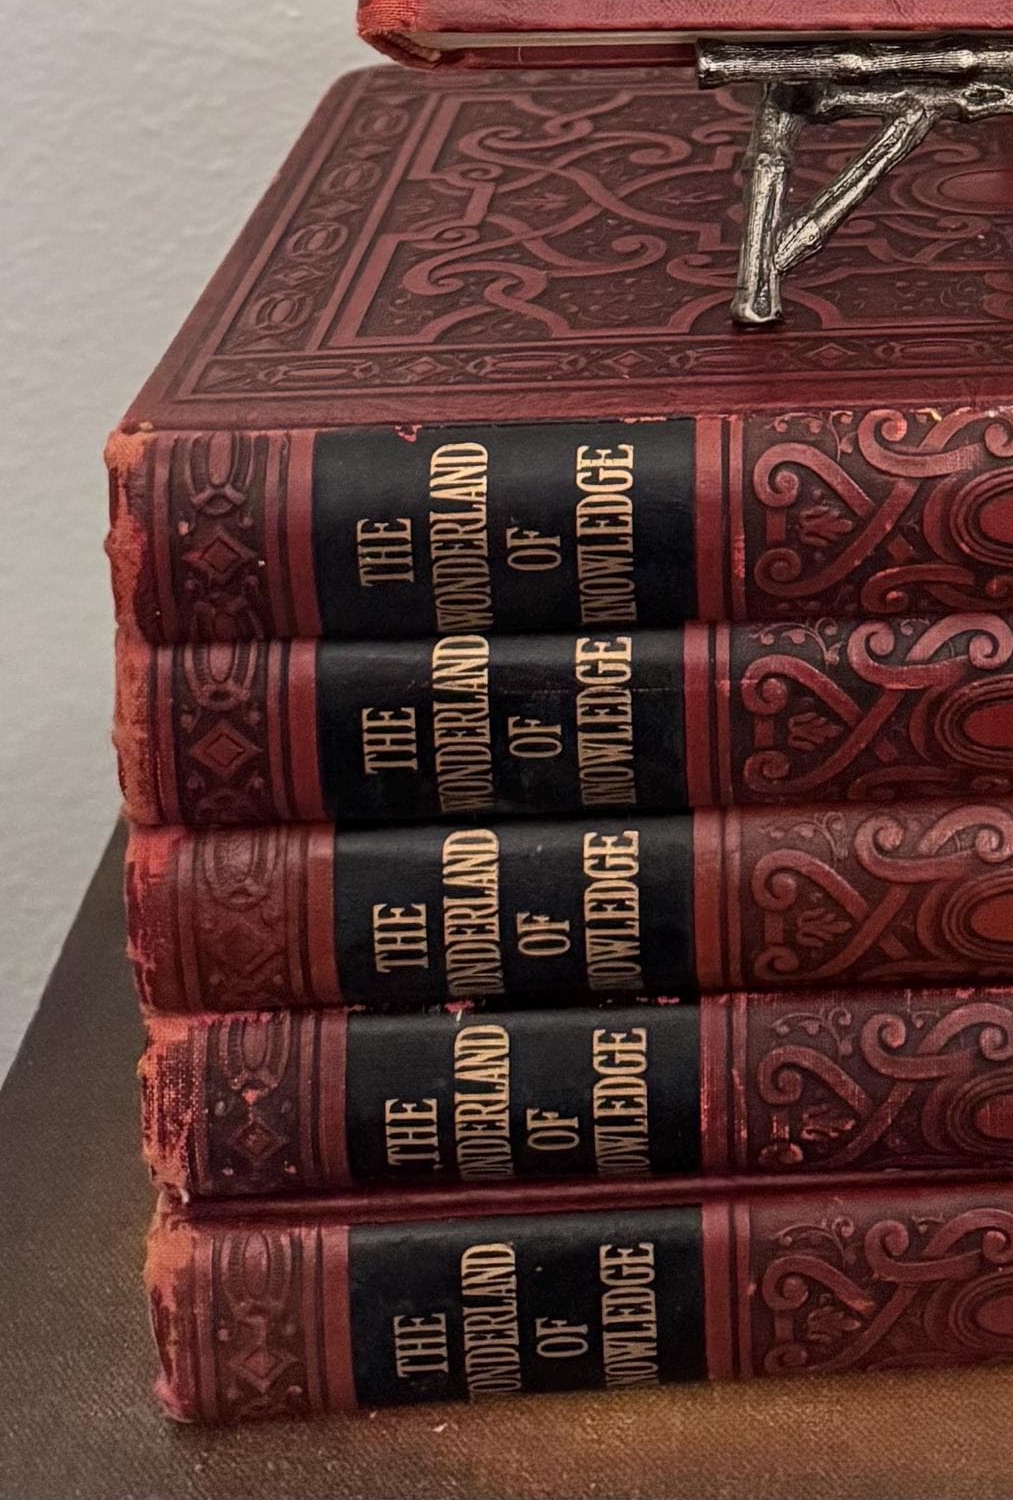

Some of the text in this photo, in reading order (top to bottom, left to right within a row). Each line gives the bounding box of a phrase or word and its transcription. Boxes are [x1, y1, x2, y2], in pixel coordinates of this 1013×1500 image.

[357, 518, 415, 586] THE
[429, 442, 493, 632] WONDERLAND
[506, 527, 562, 571] OF
[575, 443, 637, 625] KNOWLEDGE
[362, 707, 417, 775] THE
[507, 716, 562, 758] OF
[575, 636, 636, 806] KNOWLEDGE
[372, 903, 429, 973] THE
[516, 911, 571, 956] OF
[385, 1098, 440, 1166] THE
[454, 1024, 513, 1181] ONDERLAND
[526, 1108, 580, 1150] OF
[393, 1313, 449, 1378] THE
[461, 1243, 522, 1392] ONDERLAND
[535, 1317, 589, 1358] OF
[600, 1242, 659, 1387] NOWLEDGE
